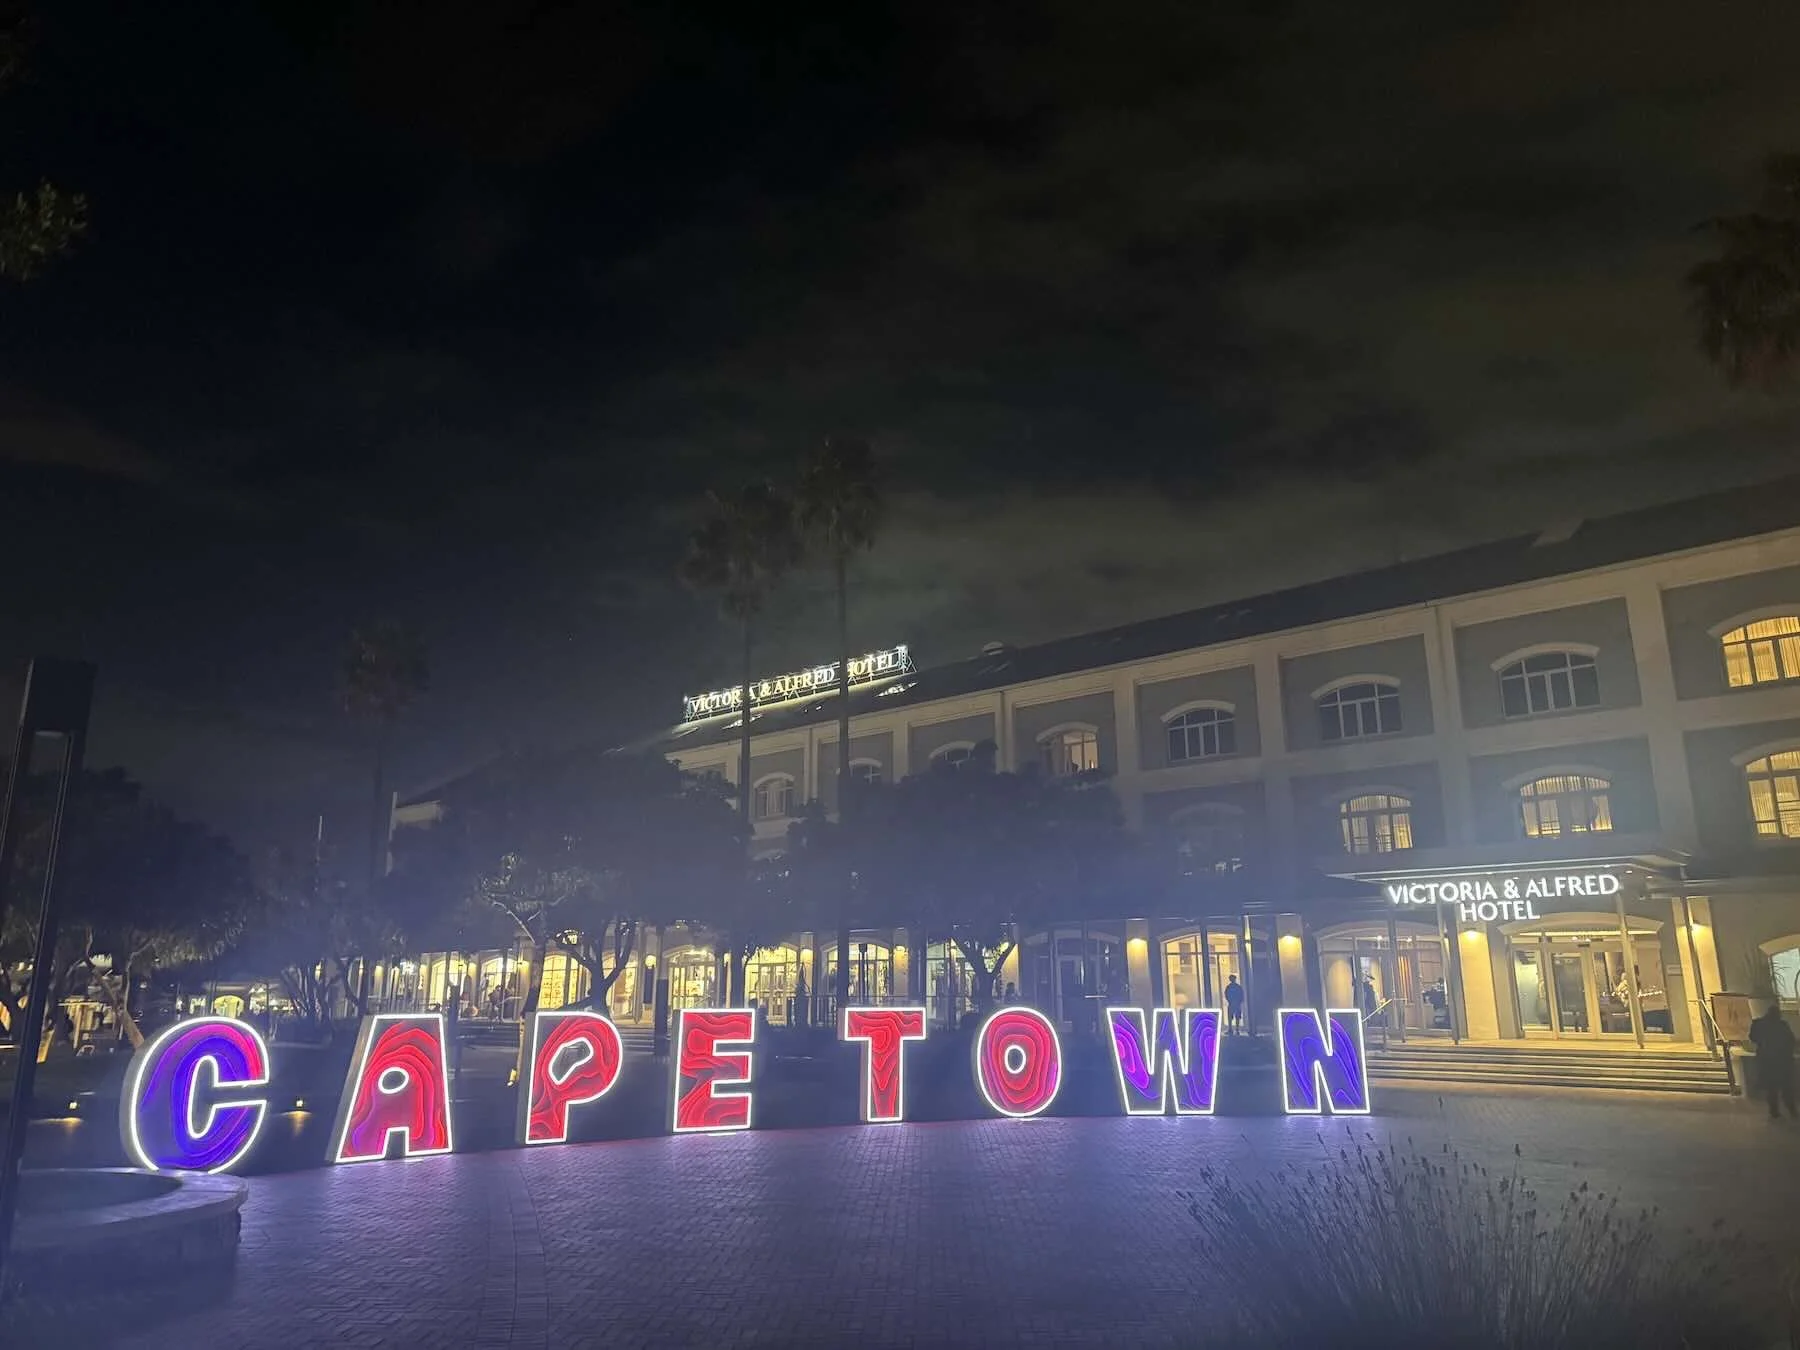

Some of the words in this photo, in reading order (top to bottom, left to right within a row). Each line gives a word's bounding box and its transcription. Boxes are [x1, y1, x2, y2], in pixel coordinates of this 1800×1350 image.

[690, 685, 757, 714] VICTORA
[760, 684, 772, 697] &
[773, 668, 835, 696] ALFRED
[1388, 881, 1498, 904] VICTORIA
[1503, 879, 1520, 899] &
[1524, 874, 1619, 897] ALFRED
[1459, 900, 1540, 922] HOTEL
